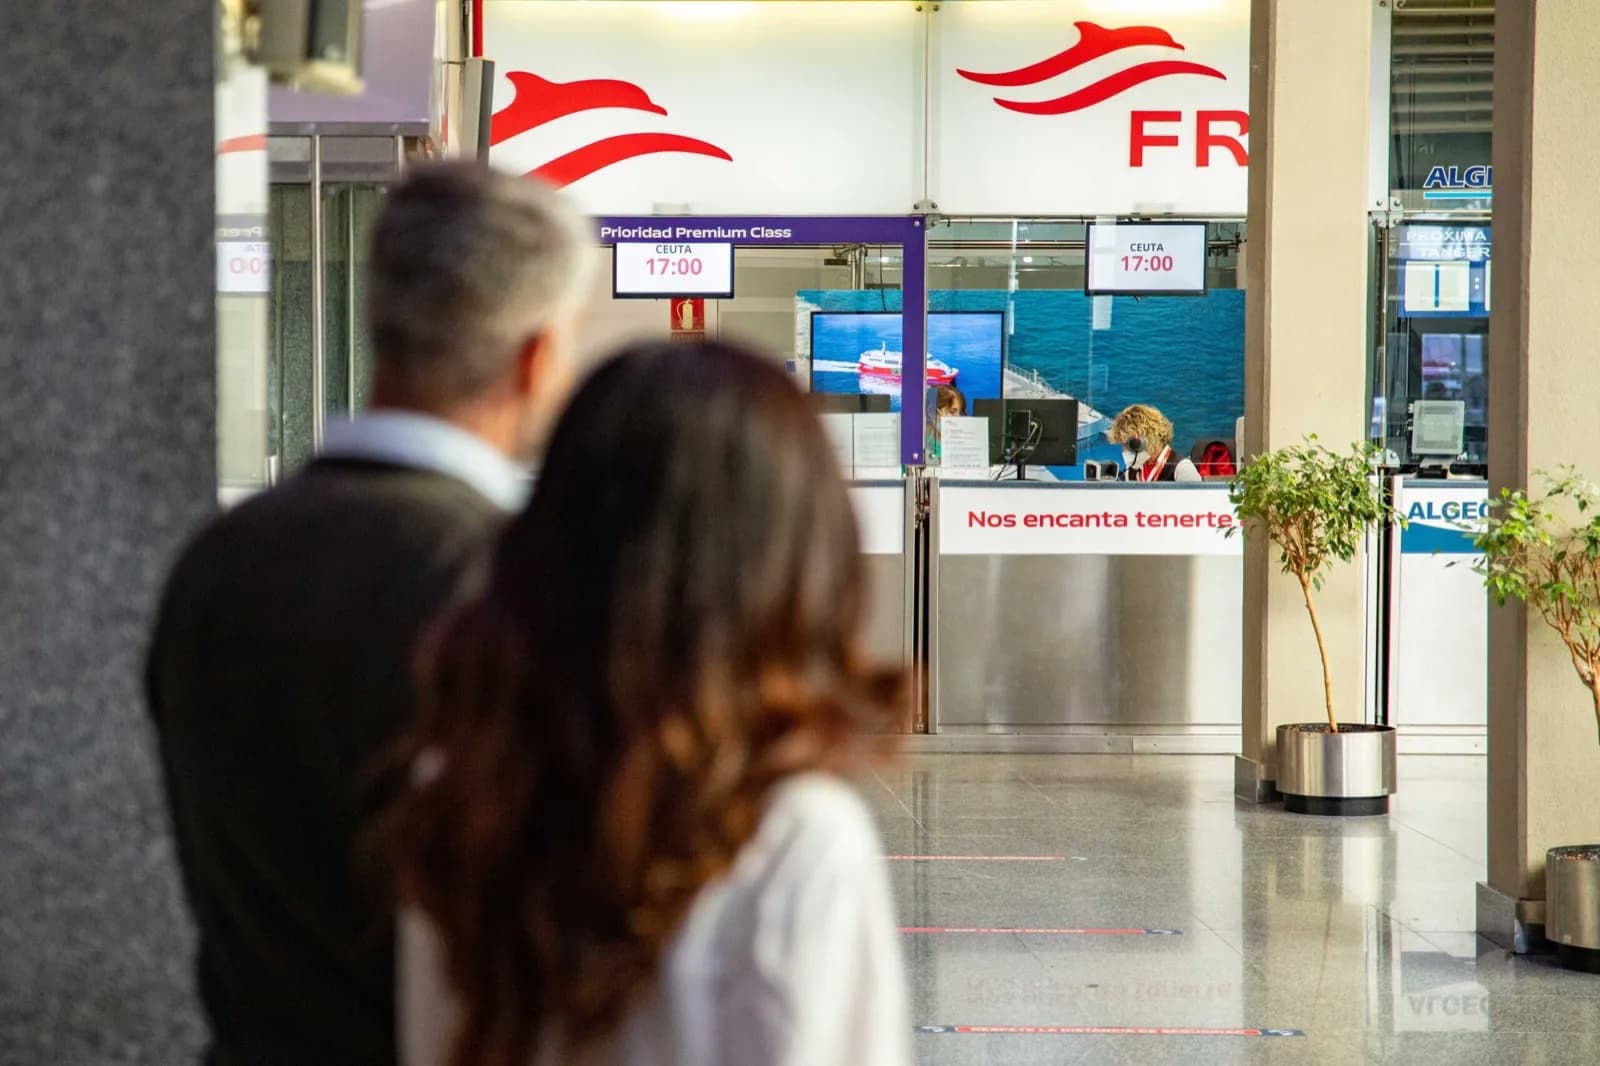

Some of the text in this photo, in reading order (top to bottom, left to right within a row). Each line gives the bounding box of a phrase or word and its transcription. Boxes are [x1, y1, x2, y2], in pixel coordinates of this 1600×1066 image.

[1129, 110, 1249, 167] FR
[600, 226, 792, 239] Prioridad Premium Class
[655, 244, 692, 254] CEUTA
[1129, 243, 1165, 252] CEUTA
[646, 258, 703, 276] 17:00
[1121, 255, 1174, 272] 17:00
[967, 511, 1017, 528] Nos
[1023, 511, 1128, 528] encanta
[1135, 511, 1233, 528] tenerte
